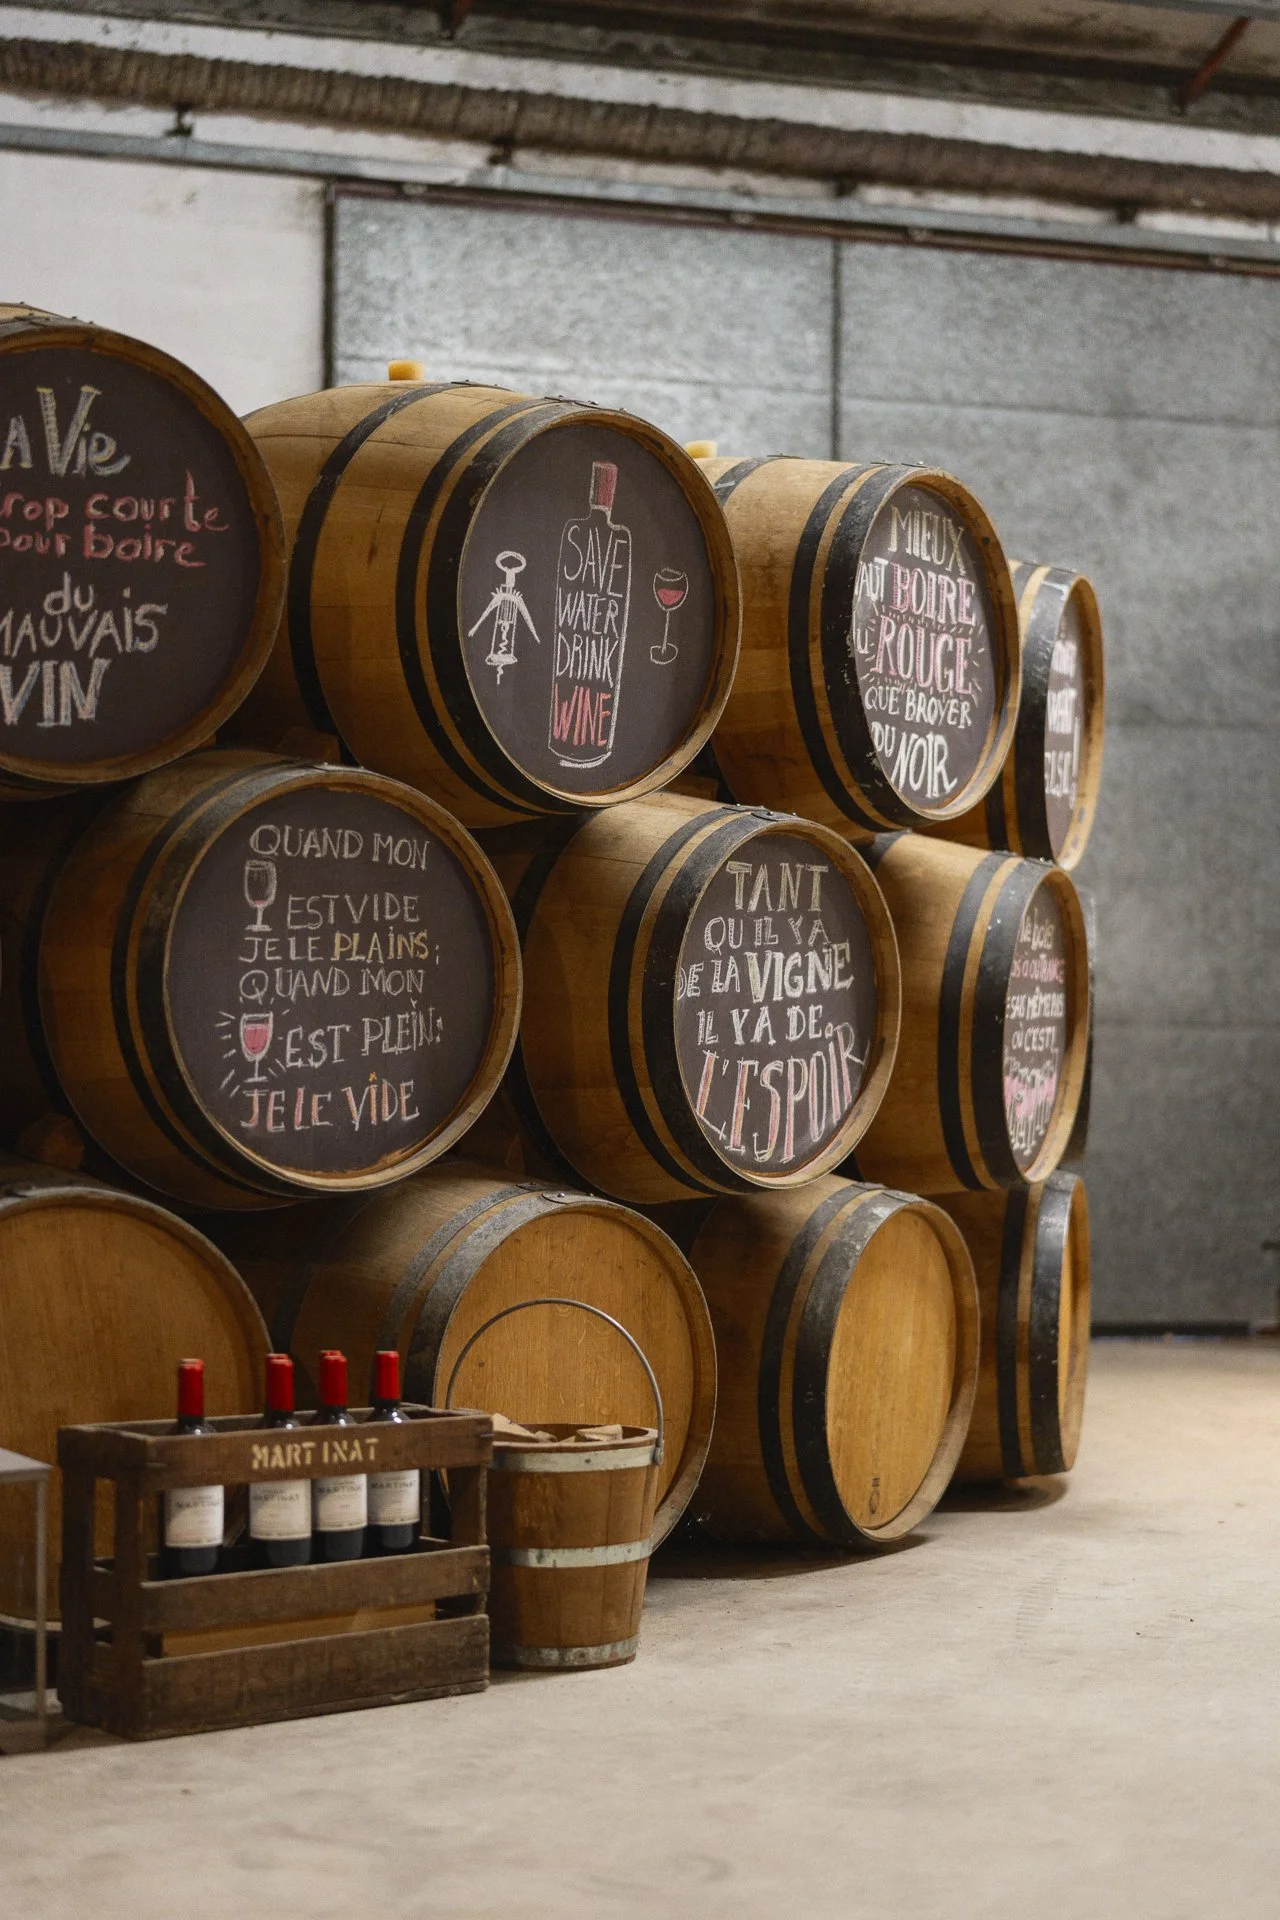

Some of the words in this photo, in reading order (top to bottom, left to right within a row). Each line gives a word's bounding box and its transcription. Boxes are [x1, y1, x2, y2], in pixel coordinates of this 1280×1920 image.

[36, 385, 132, 478] Vie
[0, 492, 69, 531] rop
[85, 469, 229, 532] courte
[84, 524, 207, 567] boire
[564, 525, 628, 598] SAVE
[887, 505, 967, 577] MIEUX
[43, 571, 94, 616] du
[558, 587, 620, 639] WATER
[889, 561, 977, 627] BOIRE
[556, 632, 619, 688] DRINK
[871, 614, 973, 695] ROUGE
[0, 657, 113, 728] VIN
[553, 683, 612, 747] WINE
[864, 685, 900, 716] QUE
[904, 688, 972, 729] BROYER
[871, 721, 896, 758] DU
[890, 731, 959, 799] NOIR
[250, 824, 363, 860] QUAND
[372, 832, 429, 871] MON
[287, 893, 340, 930] EST
[344, 892, 421, 924] VIDE
[726, 861, 828, 912] TANT
[239, 936, 282, 963] JE
[288, 936, 324, 962] LE
[711, 955, 741, 993] LA
[743, 938, 854, 1003] VIGNE
[239, 965, 350, 1005] QUAND
[359, 967, 426, 996] MON
[286, 1025, 351, 1068] EST
[696, 1008, 719, 1046] IL
[240, 1088, 285, 1133] JE
[294, 1087, 333, 1131] LE
[251, 1437, 379, 1470] MARTINAT
